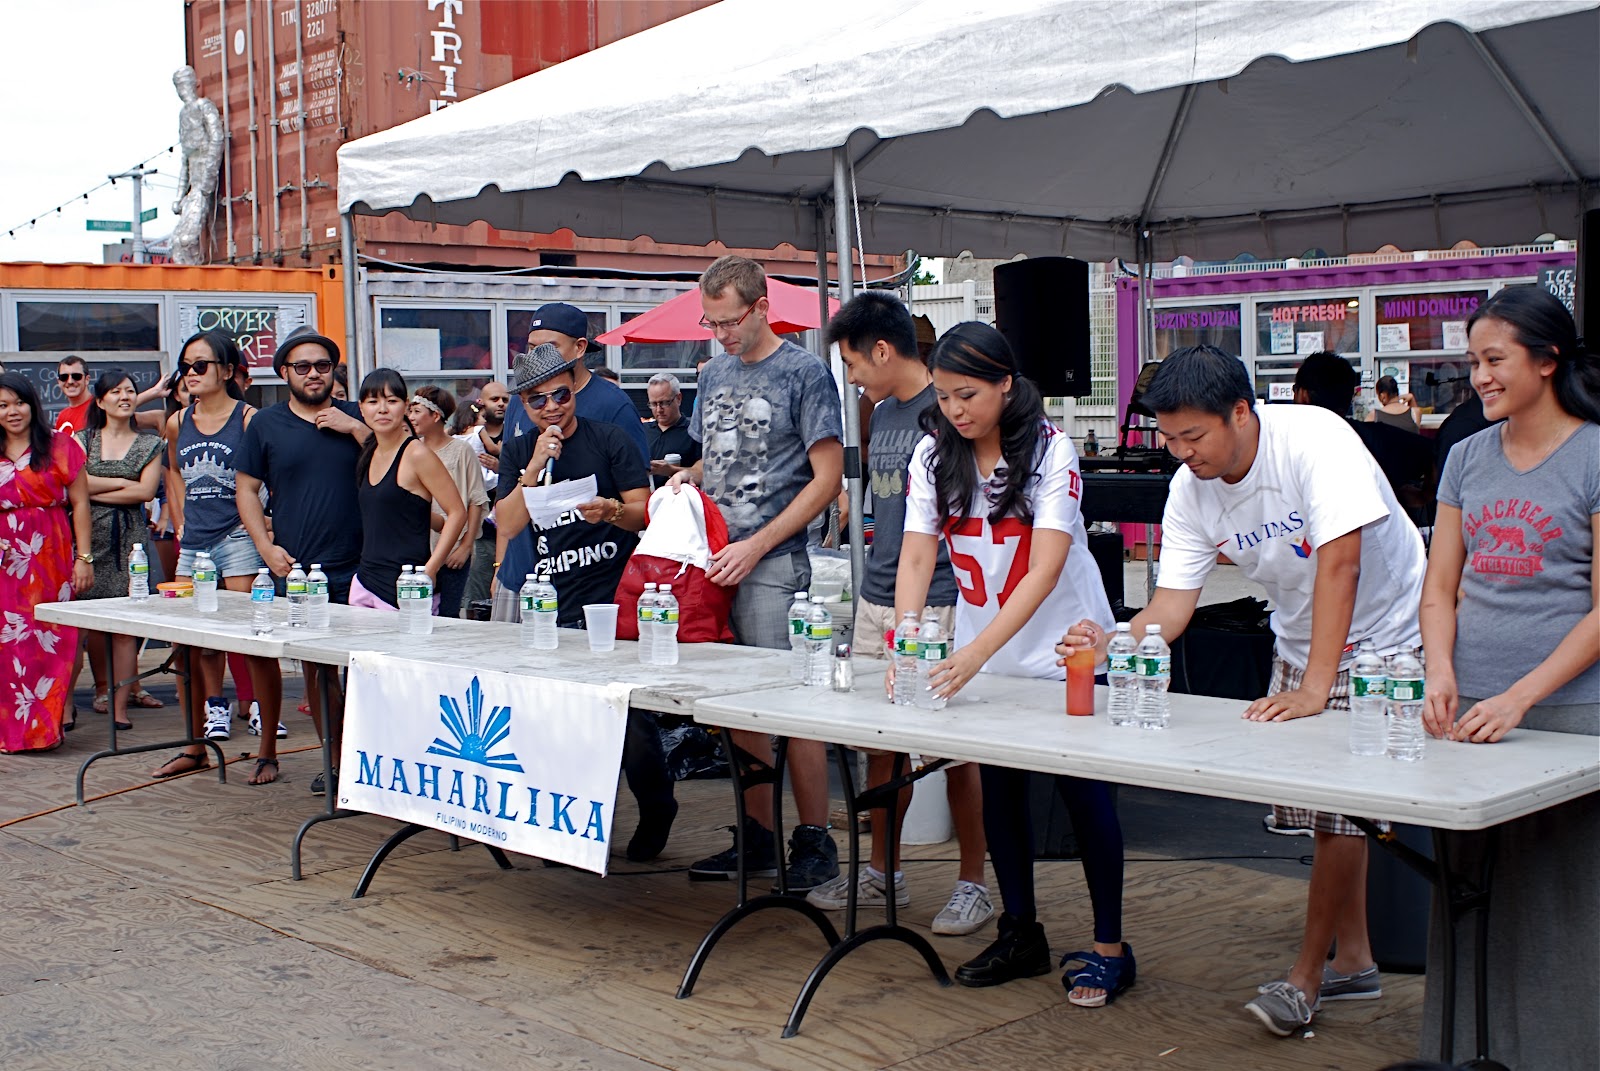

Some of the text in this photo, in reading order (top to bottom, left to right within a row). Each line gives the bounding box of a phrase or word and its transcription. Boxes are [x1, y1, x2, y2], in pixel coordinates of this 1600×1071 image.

[1545, 269, 1573, 286] ICE
[1550, 281, 1576, 297] DRI
[1272, 303, 1346, 323] HOT FRESH
[1384, 297, 1479, 318] MINI DONUTS
[199, 307, 274, 333] ORDER
[1200, 309, 1239, 327] DUZIN
[880, 453, 907, 470] PEEPS
[1464, 498, 1563, 543] BLACKBEAR
[943, 517, 1033, 609] 57
[1476, 556, 1531, 574] ATHLETICS
[355, 750, 606, 842] MAHARLIKA
[436, 812, 507, 842] FILIPINO MODERNO
